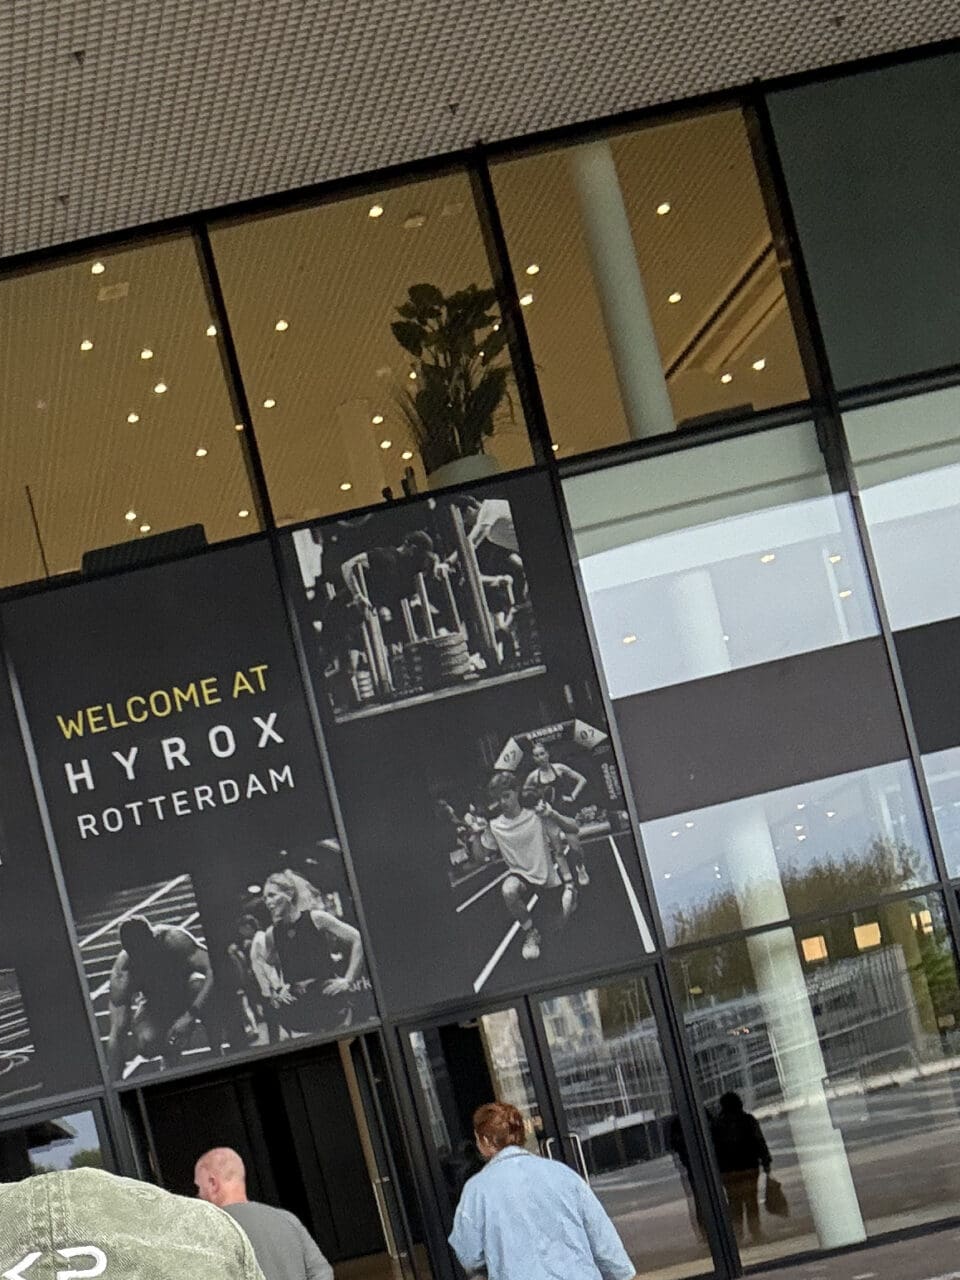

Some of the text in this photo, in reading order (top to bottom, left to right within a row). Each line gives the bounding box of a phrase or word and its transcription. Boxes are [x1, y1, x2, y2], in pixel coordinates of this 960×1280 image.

[56, 665, 269, 740] WELCOME AT
[580, 728, 595, 740] 07
[64, 712, 285, 794] HYROX
[77, 765, 295, 839] ROTTERDAM
